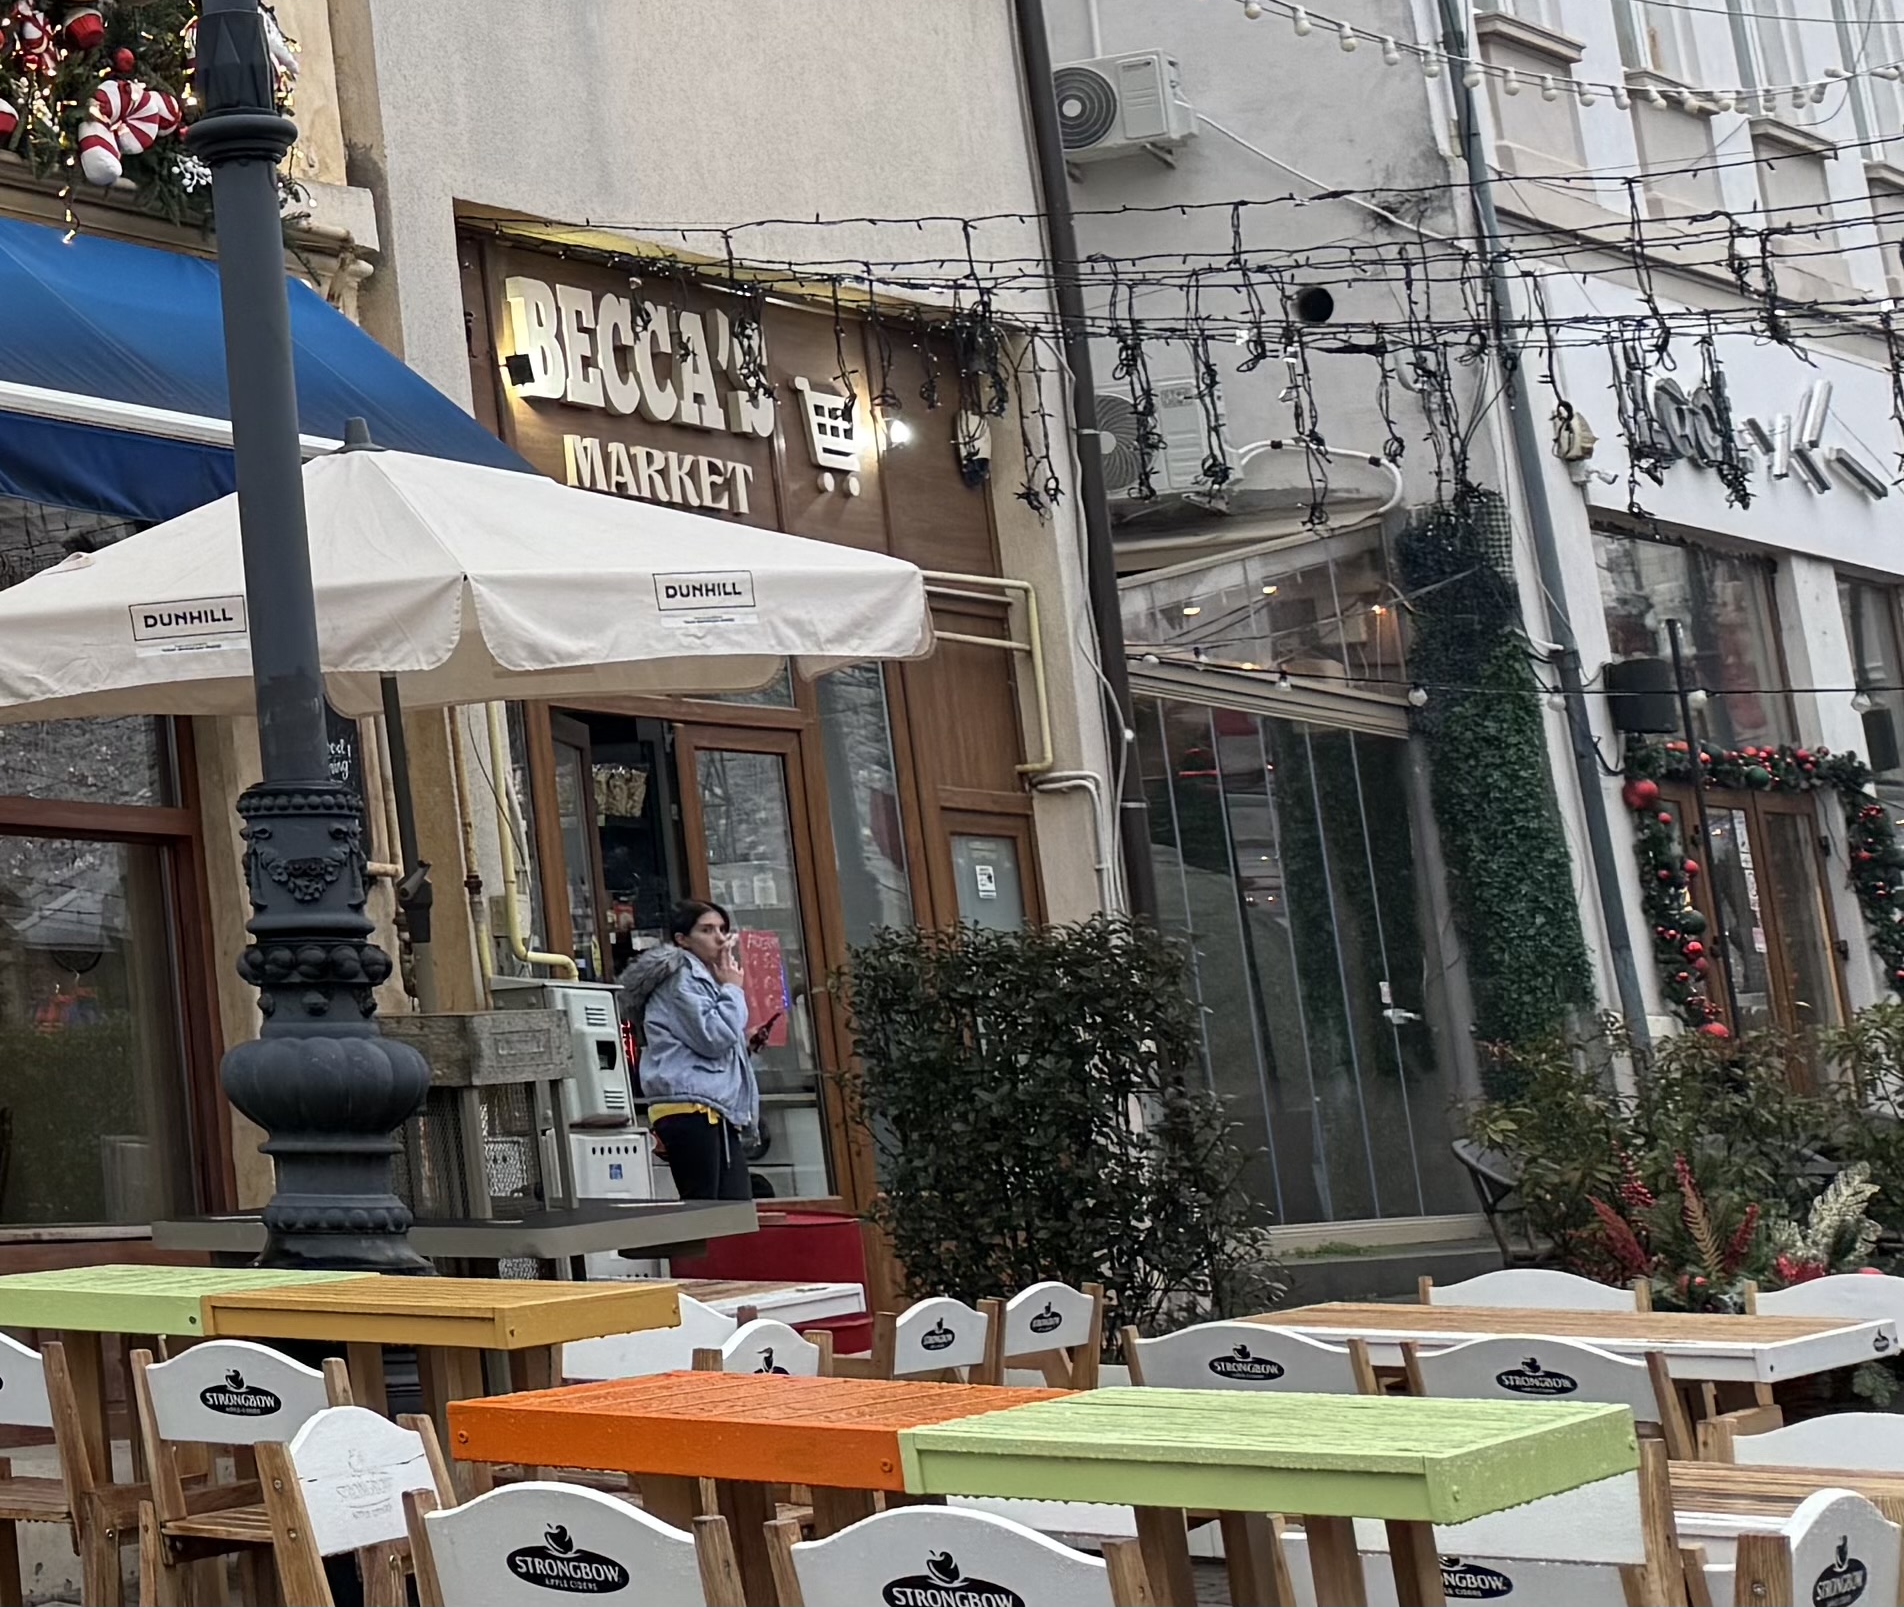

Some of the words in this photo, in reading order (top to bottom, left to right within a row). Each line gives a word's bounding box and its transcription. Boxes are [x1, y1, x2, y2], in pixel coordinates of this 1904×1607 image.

[505, 275, 775, 439] BECCA'S
[563, 434, 754, 514] MARKET
[664, 581, 743, 600] DUNHILL
[143, 607, 234, 629] DUNHILL
[1213, 1361, 1280, 1376] STRONGBOW
[204, 1392, 276, 1409] STRONGBOW
[514, 1555, 620, 1583] STRONGBOW
[1442, 1571, 1505, 1592] NGBOW
[891, 1587, 1013, 1607] STRONGBOW
